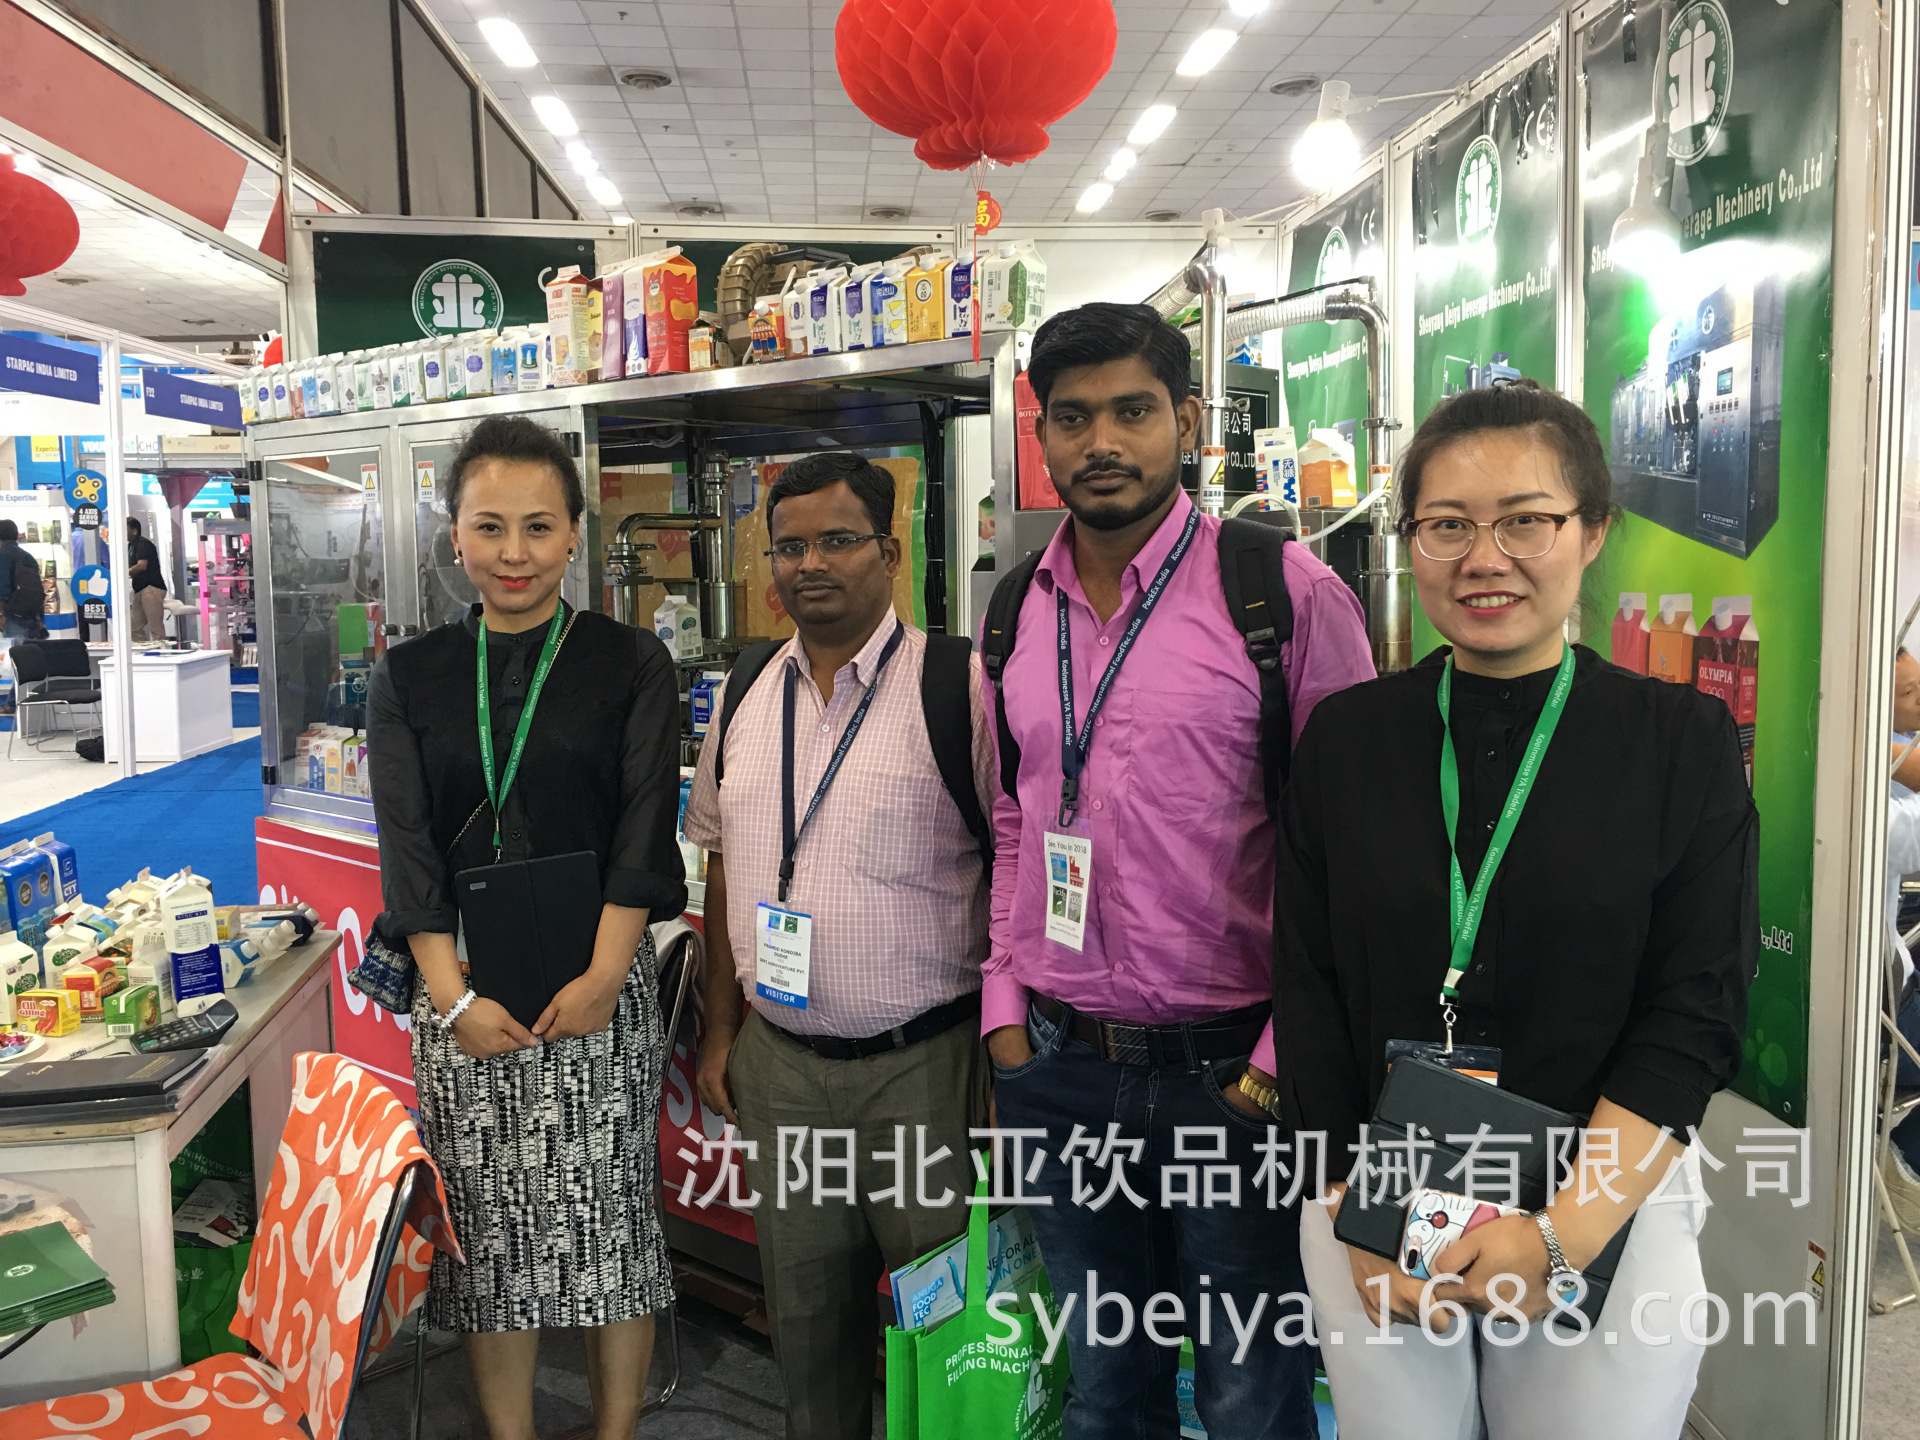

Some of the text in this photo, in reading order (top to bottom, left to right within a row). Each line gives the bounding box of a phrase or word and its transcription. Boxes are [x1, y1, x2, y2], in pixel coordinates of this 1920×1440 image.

[1716, 180, 1774, 228] Machinery
[1778, 152, 1823, 203] Co.,Ltd
[1488, 280, 1525, 310] Machinery
[6, 356, 78, 382] STARPAC INDIA LIMITED
[6, 494, 37, 502] Expertise
[1141, 568, 1170, 610] PackEx India
[84, 603, 106, 613] BEST
[1079, 618, 1142, 752] ANUTEC International FoodTec India
[1699, 666, 1733, 685] OLYMPIA
[1060, 660, 1074, 746] Koelnmesse YA Tradefair
[820, 748, 845, 789] International
[840, 722, 858, 750] FoodTec
[854, 708, 866, 723] India
[1522, 733, 1546, 777] Koelnmesse
[1517, 777, 1530, 787] YA
[1057, 841, 1067, 851] You
[1461, 846, 1500, 941] Koelnmesse YA Tradefair
[765, 987, 795, 1003] VISITOR
[912, 1292, 937, 1312] FOOD
[913, 1306, 930, 1321] TEC
[945, 1341, 1034, 1371] PROFESSIONAL
[947, 1356, 987, 1387] FILLING
